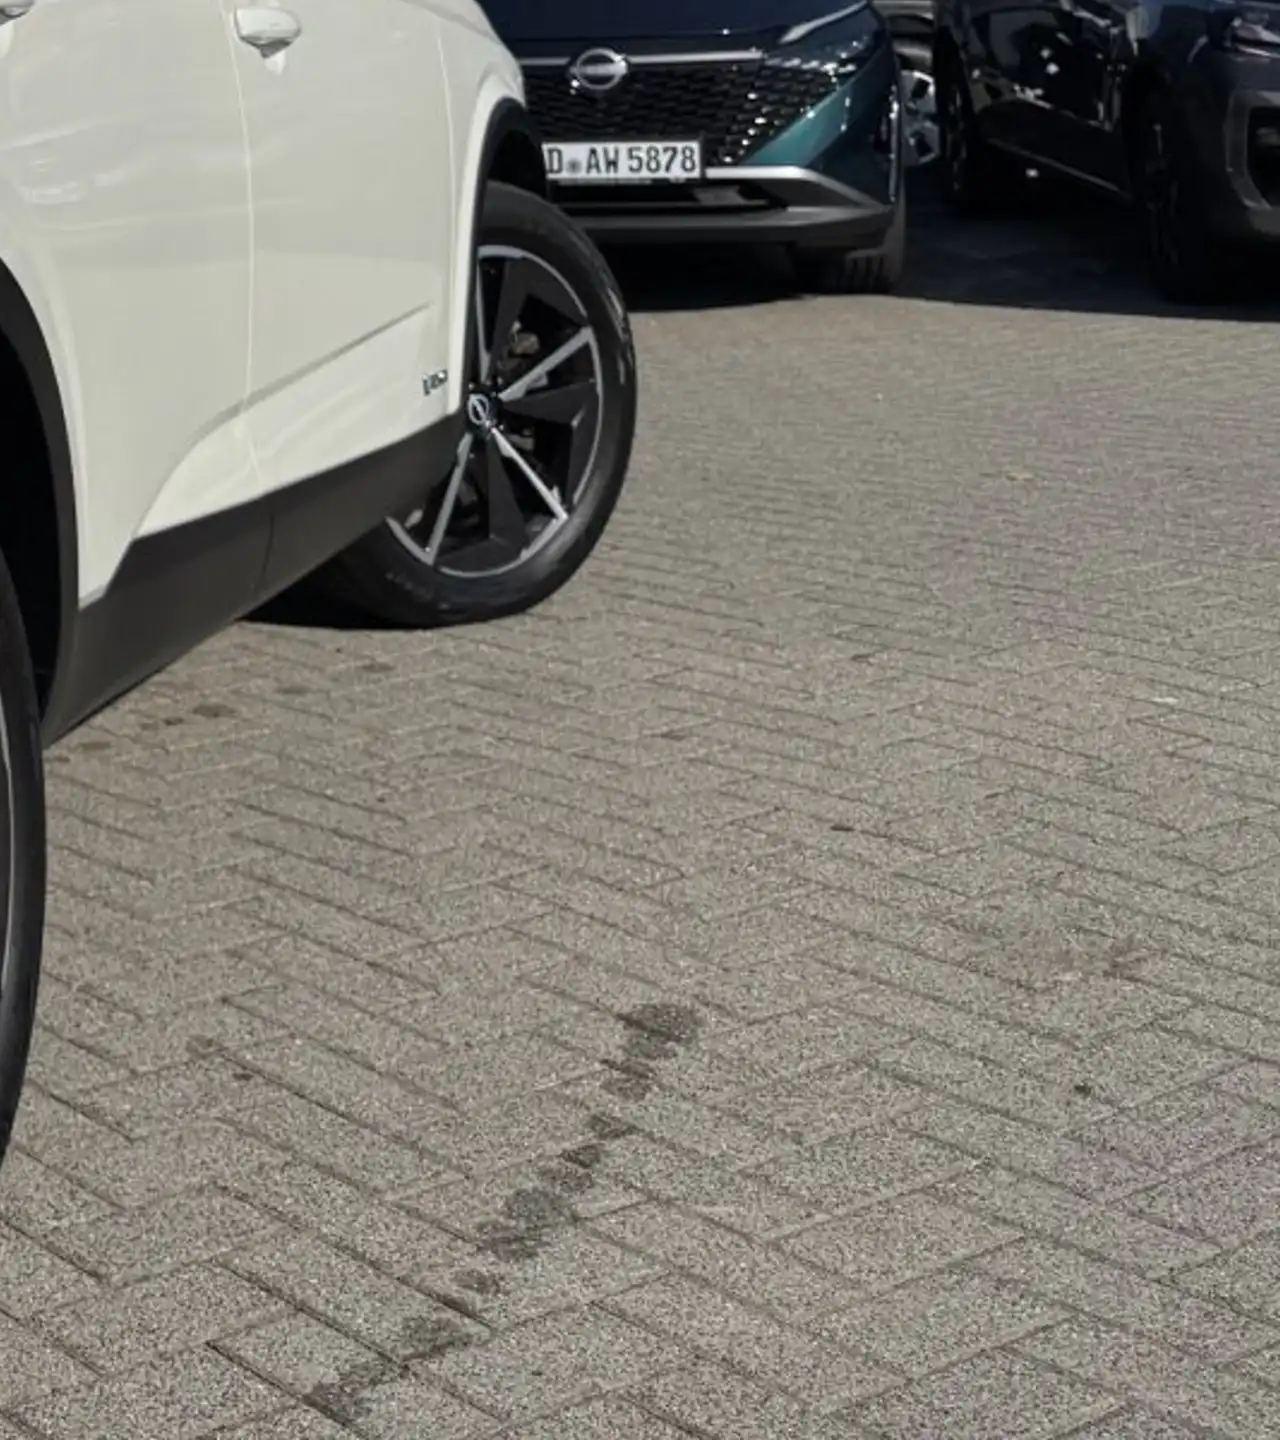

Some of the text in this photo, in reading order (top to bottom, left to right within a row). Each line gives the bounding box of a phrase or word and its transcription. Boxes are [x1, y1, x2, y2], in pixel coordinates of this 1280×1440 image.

[547, 145, 696, 174] D AW 5878
